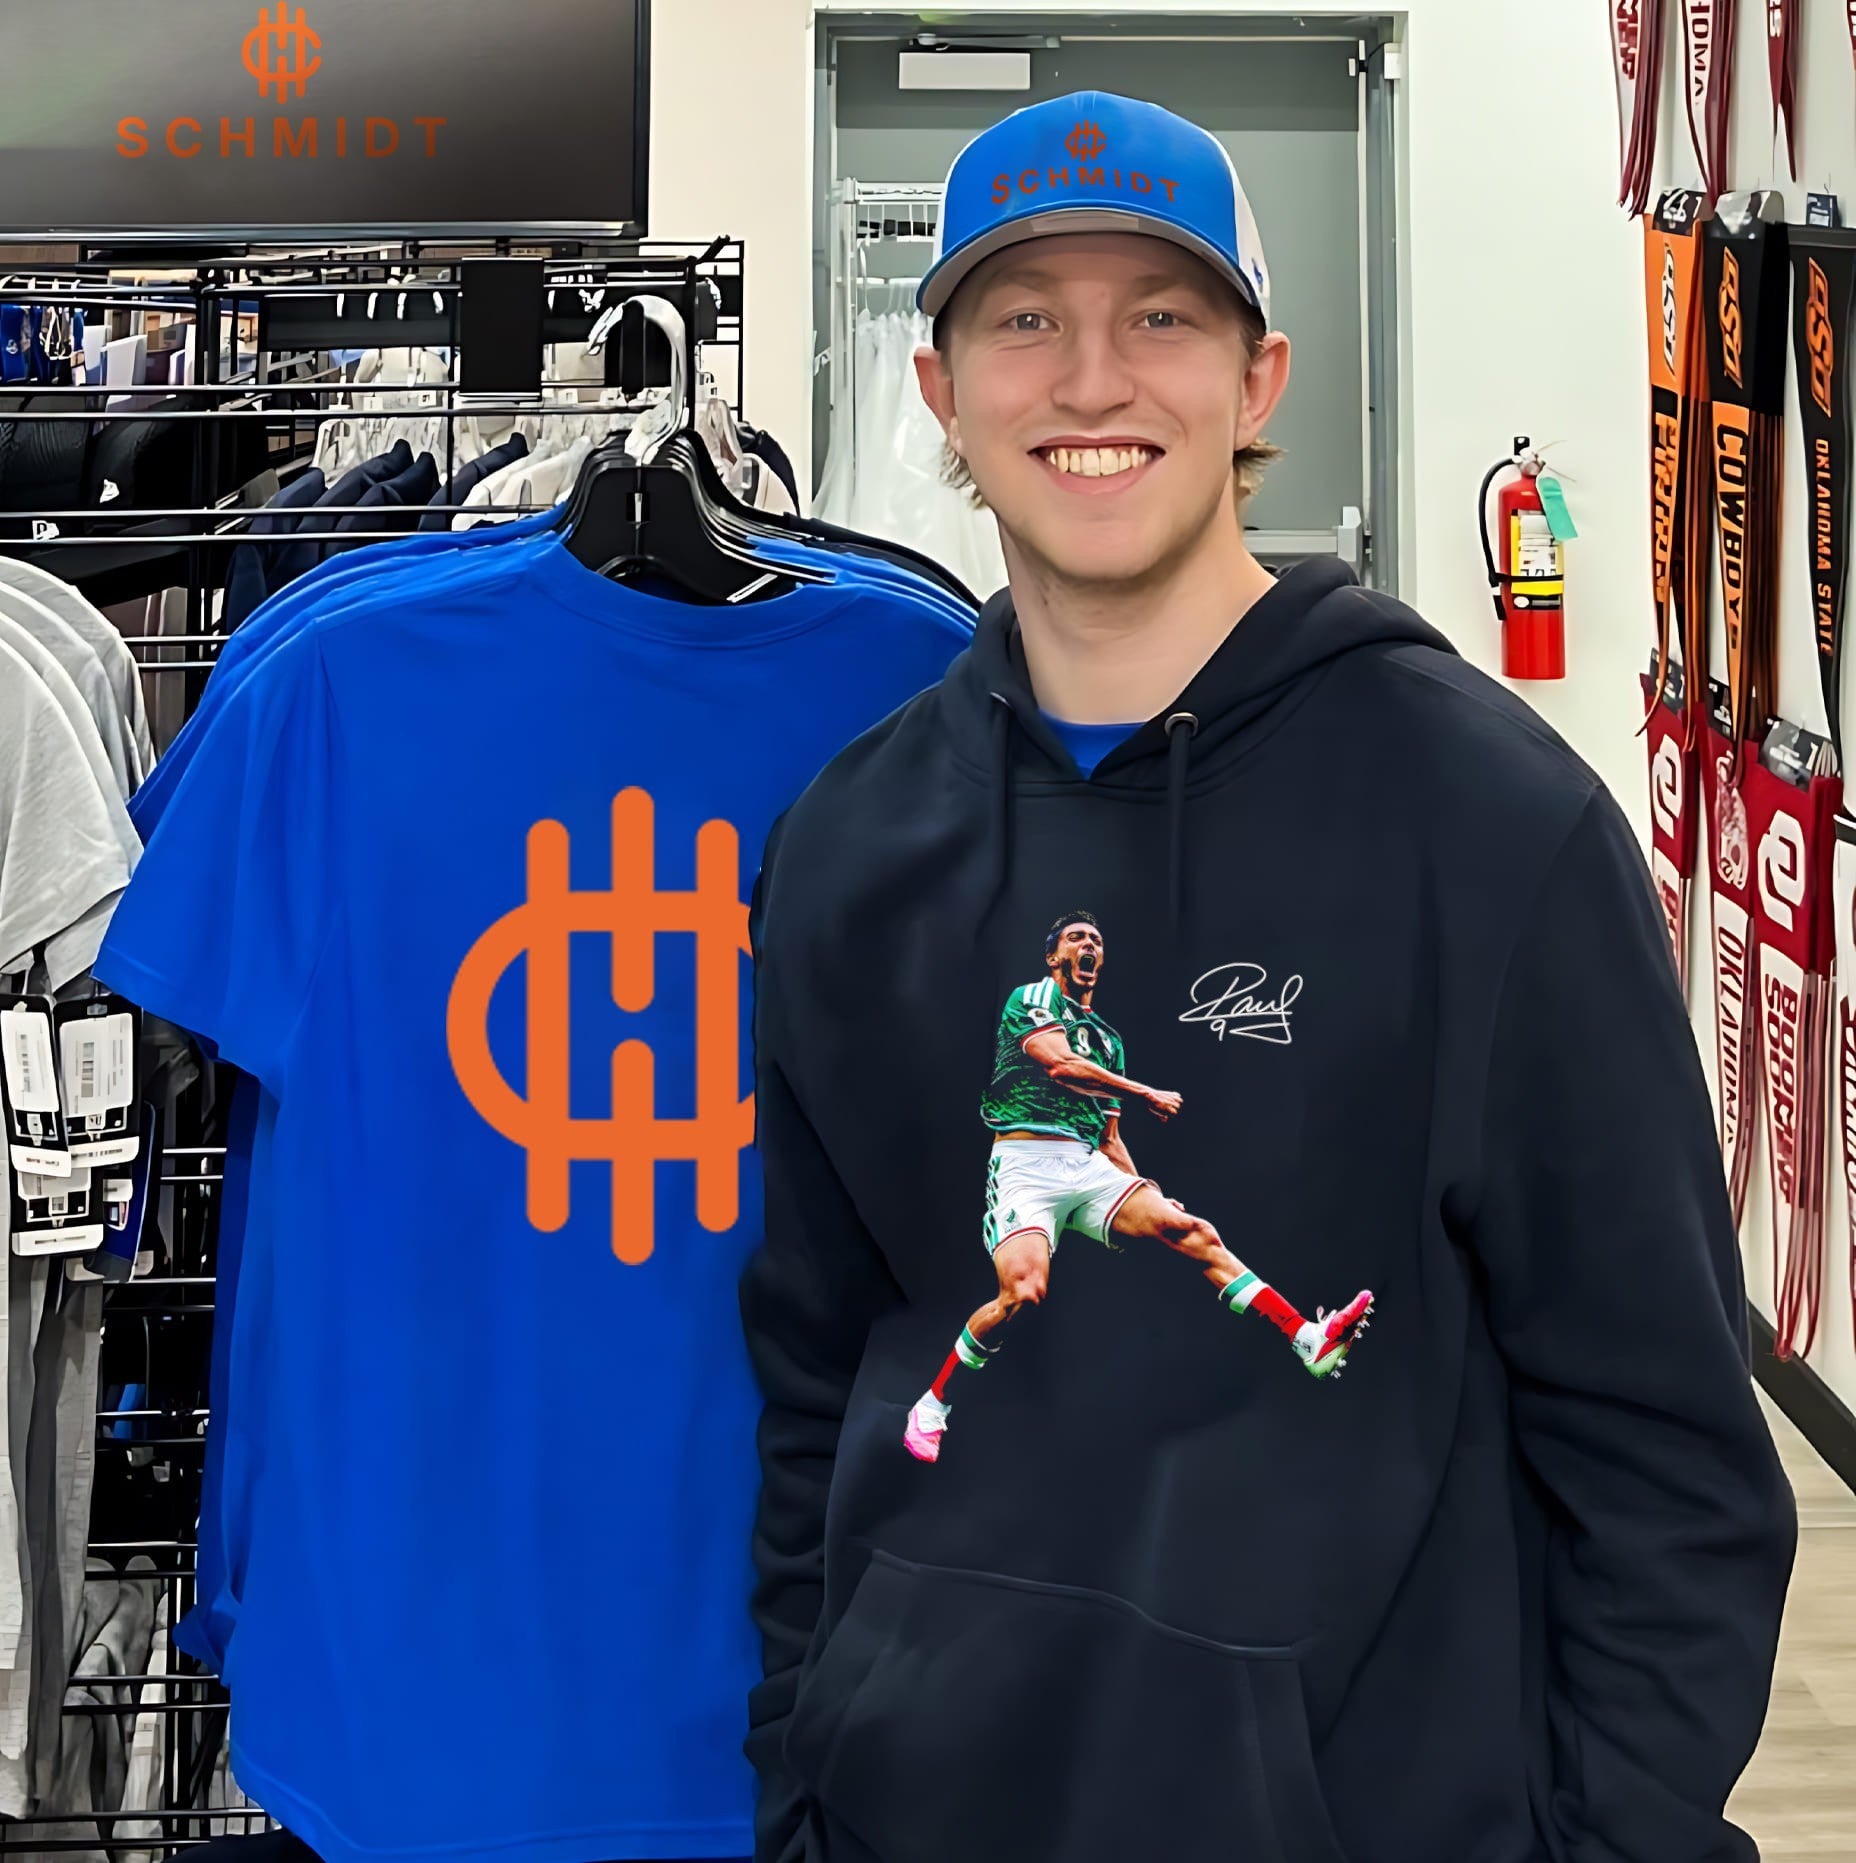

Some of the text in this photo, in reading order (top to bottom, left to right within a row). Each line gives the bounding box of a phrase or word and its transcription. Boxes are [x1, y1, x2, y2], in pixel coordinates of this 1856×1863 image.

[115, 116, 448, 159] SCHMIDT
[992, 166, 1179, 205] SCHMIDT
[1815, 438, 1833, 570] OKLAHOMA
